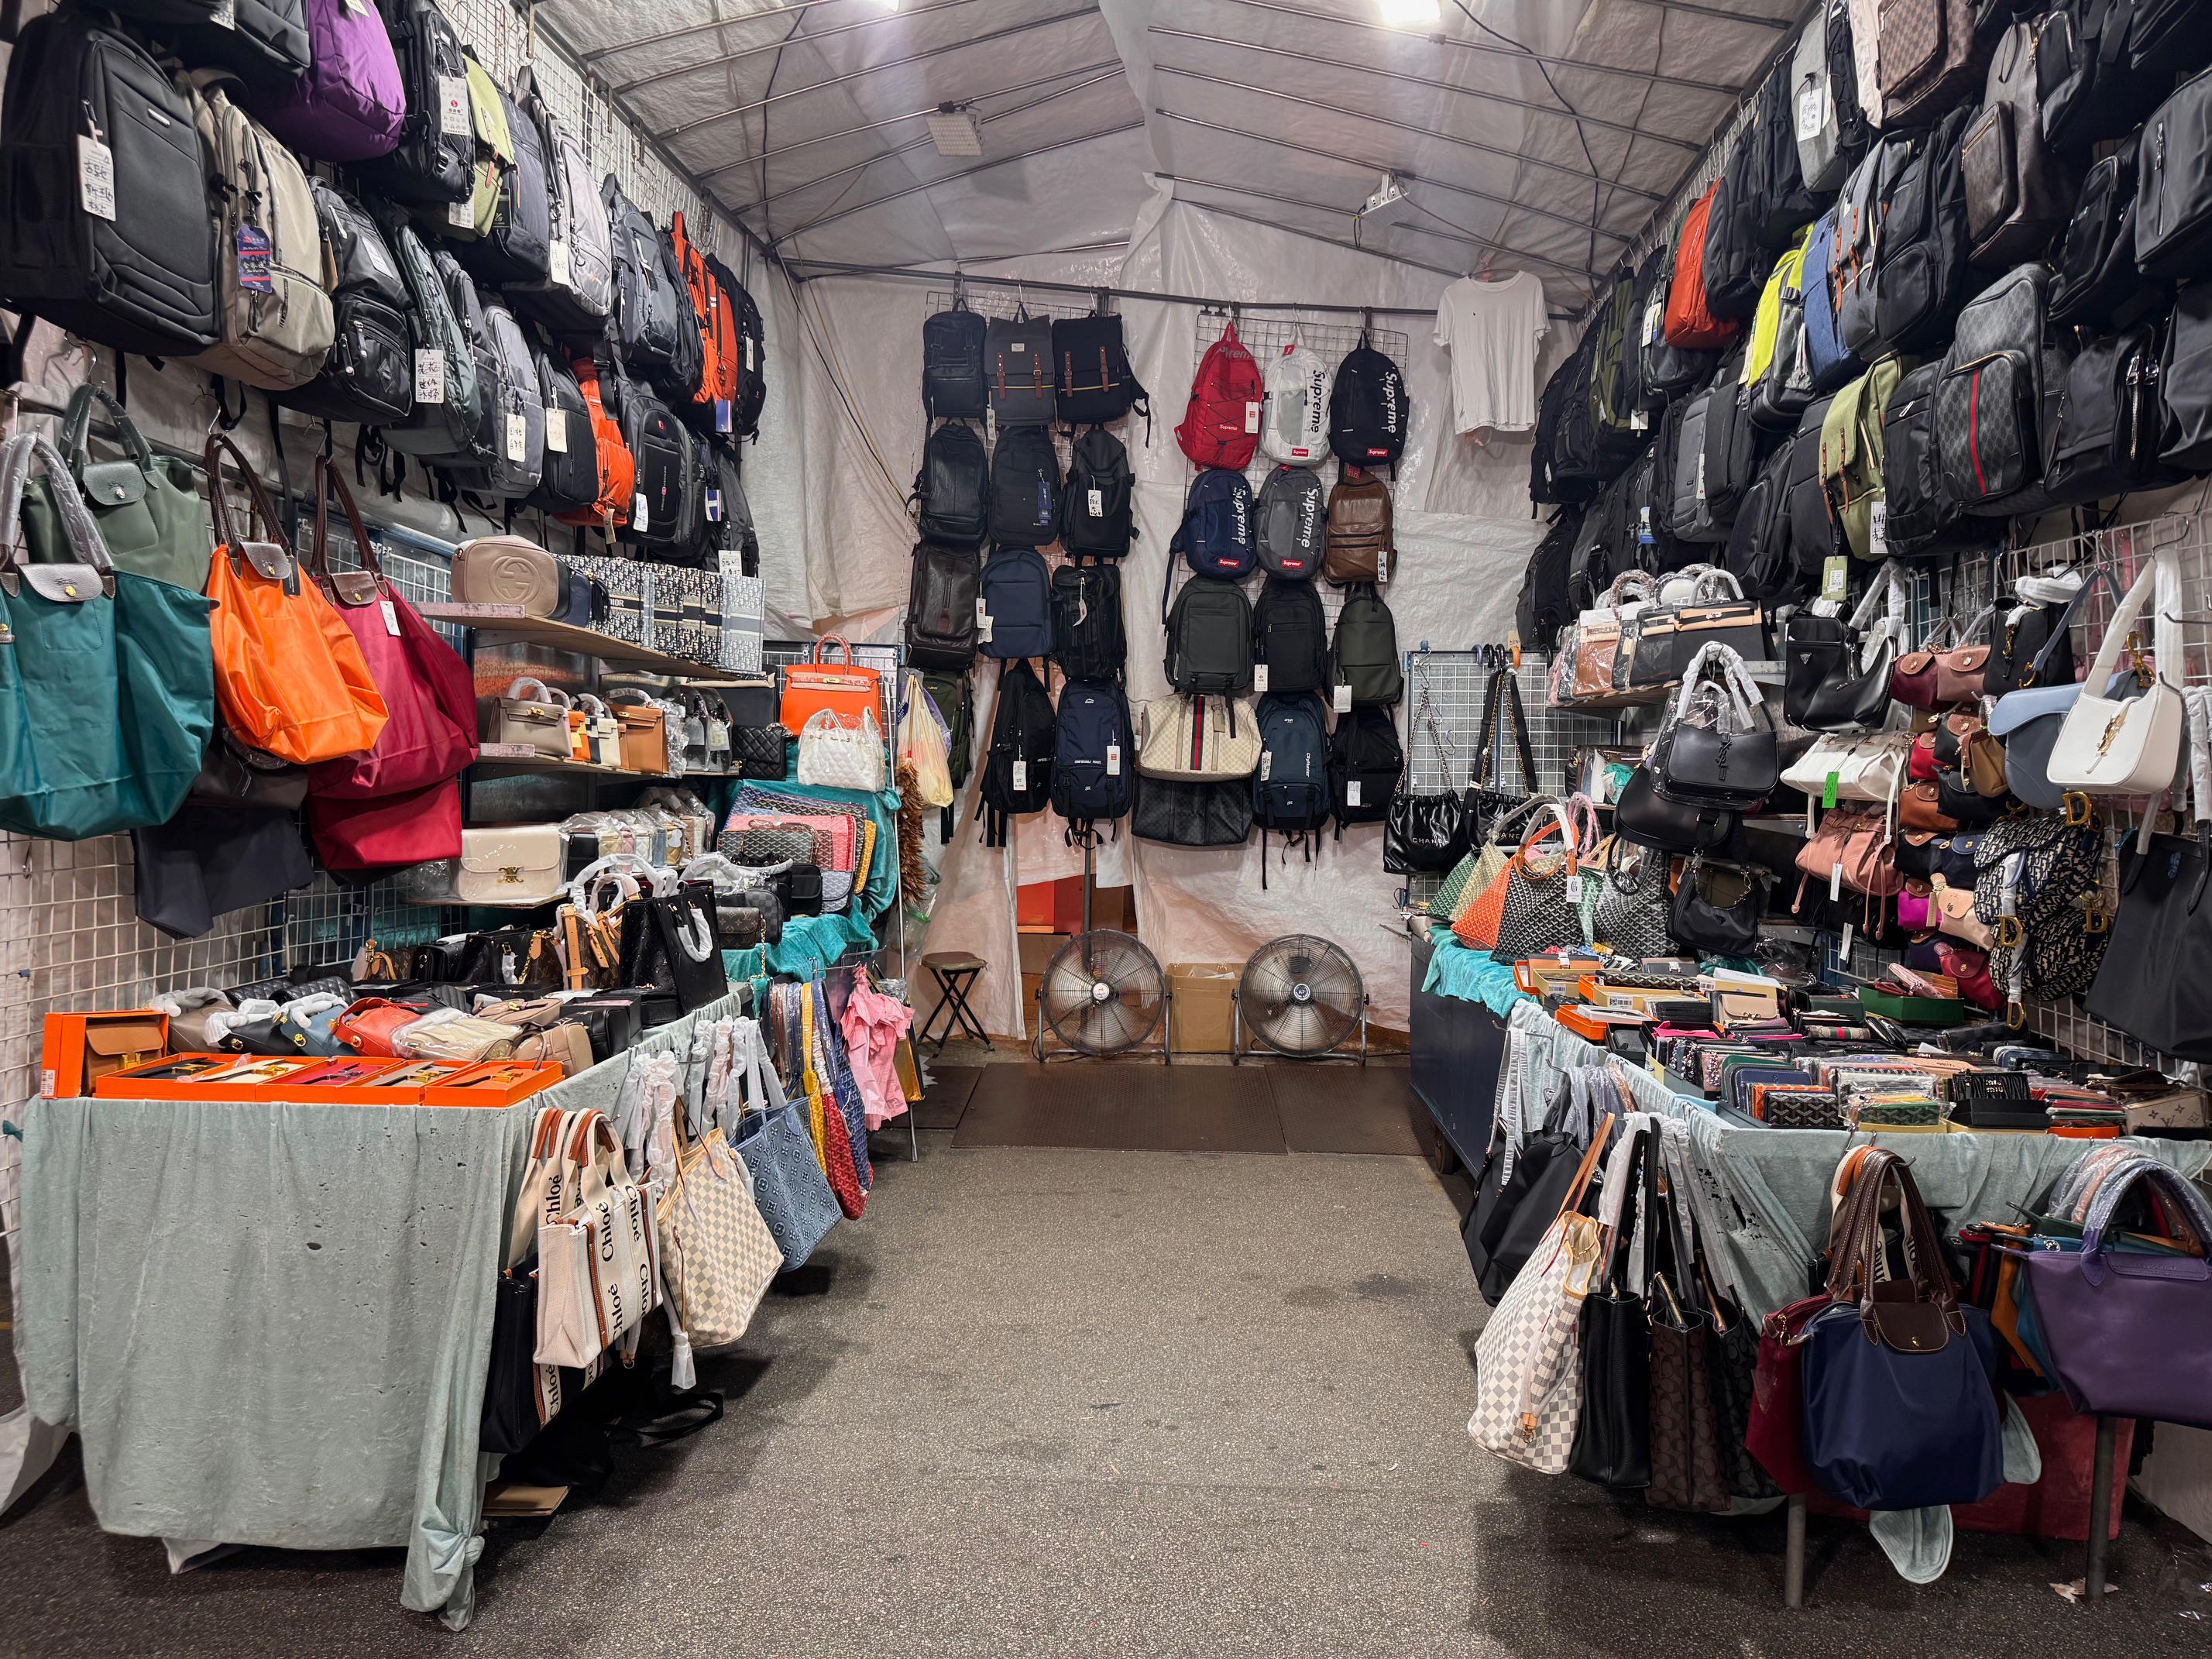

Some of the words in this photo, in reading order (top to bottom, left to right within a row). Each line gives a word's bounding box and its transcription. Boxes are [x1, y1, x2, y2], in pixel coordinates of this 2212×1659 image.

[1310, 369, 1325, 433] Supreme
[1382, 372, 1397, 433] Supreme
[1233, 487, 1246, 544] Supreme
[1300, 488, 1318, 548] Supreme
[546, 1174, 562, 1225] Chloé
[624, 1185, 641, 1242] Chloé
[595, 1201, 614, 1262] Chloé
[546, 1365, 558, 1418] Chloé
